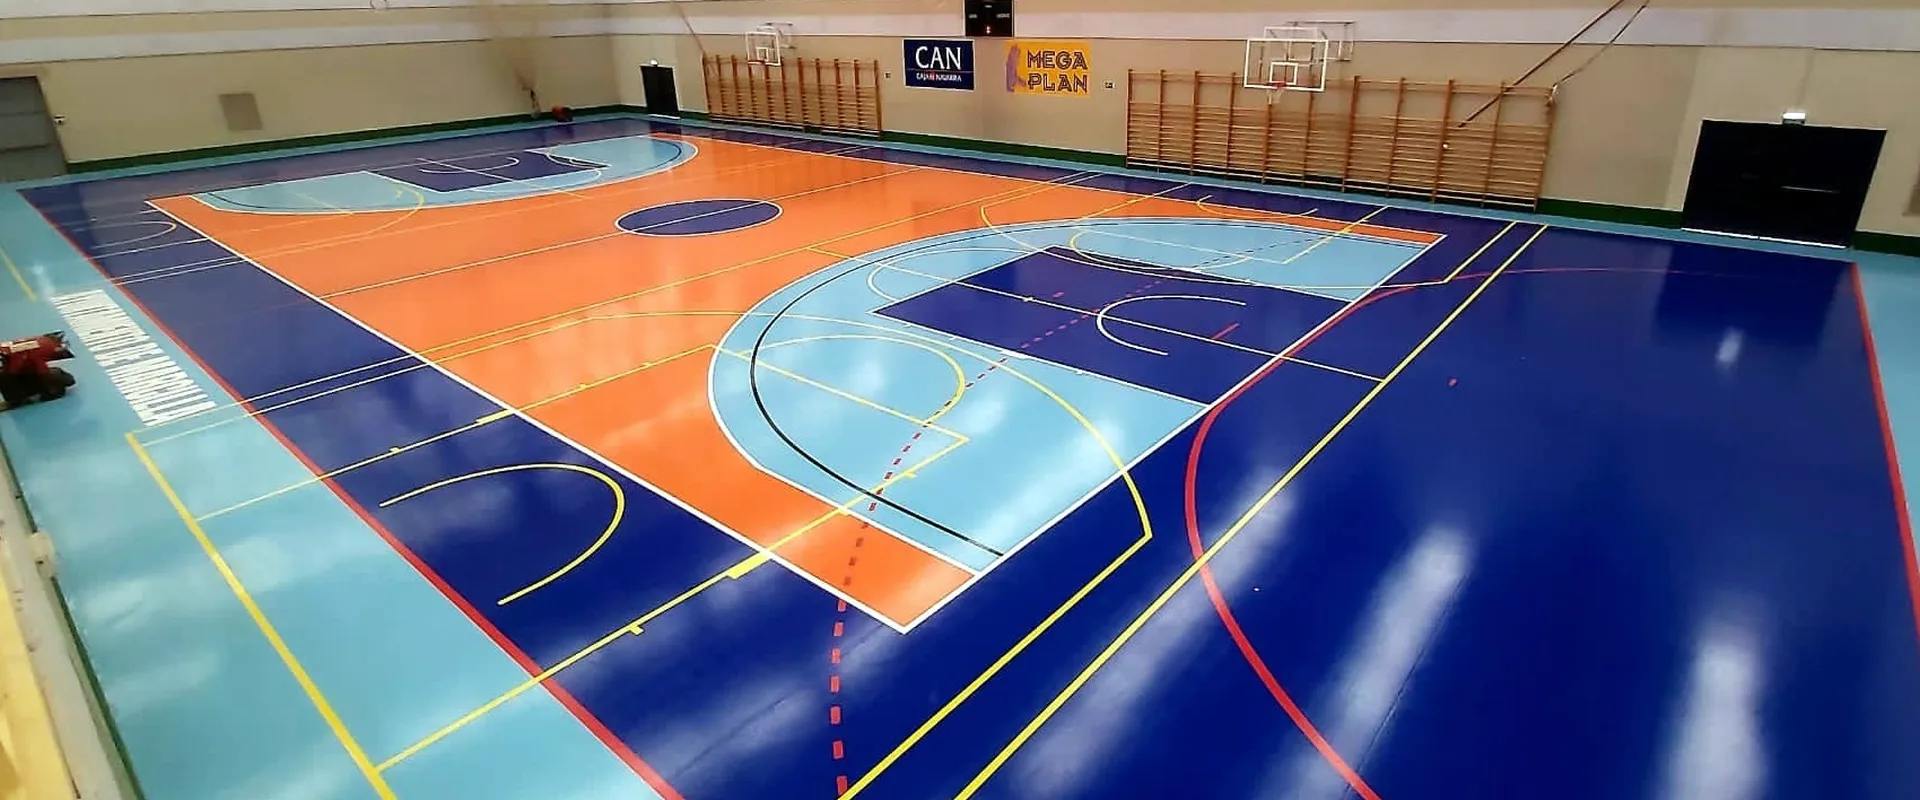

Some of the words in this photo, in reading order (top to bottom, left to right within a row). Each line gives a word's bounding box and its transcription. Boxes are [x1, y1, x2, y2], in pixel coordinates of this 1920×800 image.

[915, 46, 962, 70] CAN
[1027, 50, 1088, 70] MEGA
[1027, 73, 1088, 92] PLAN
[94, 342, 164, 367] DE
[105, 355, 218, 426] MARCILLA
